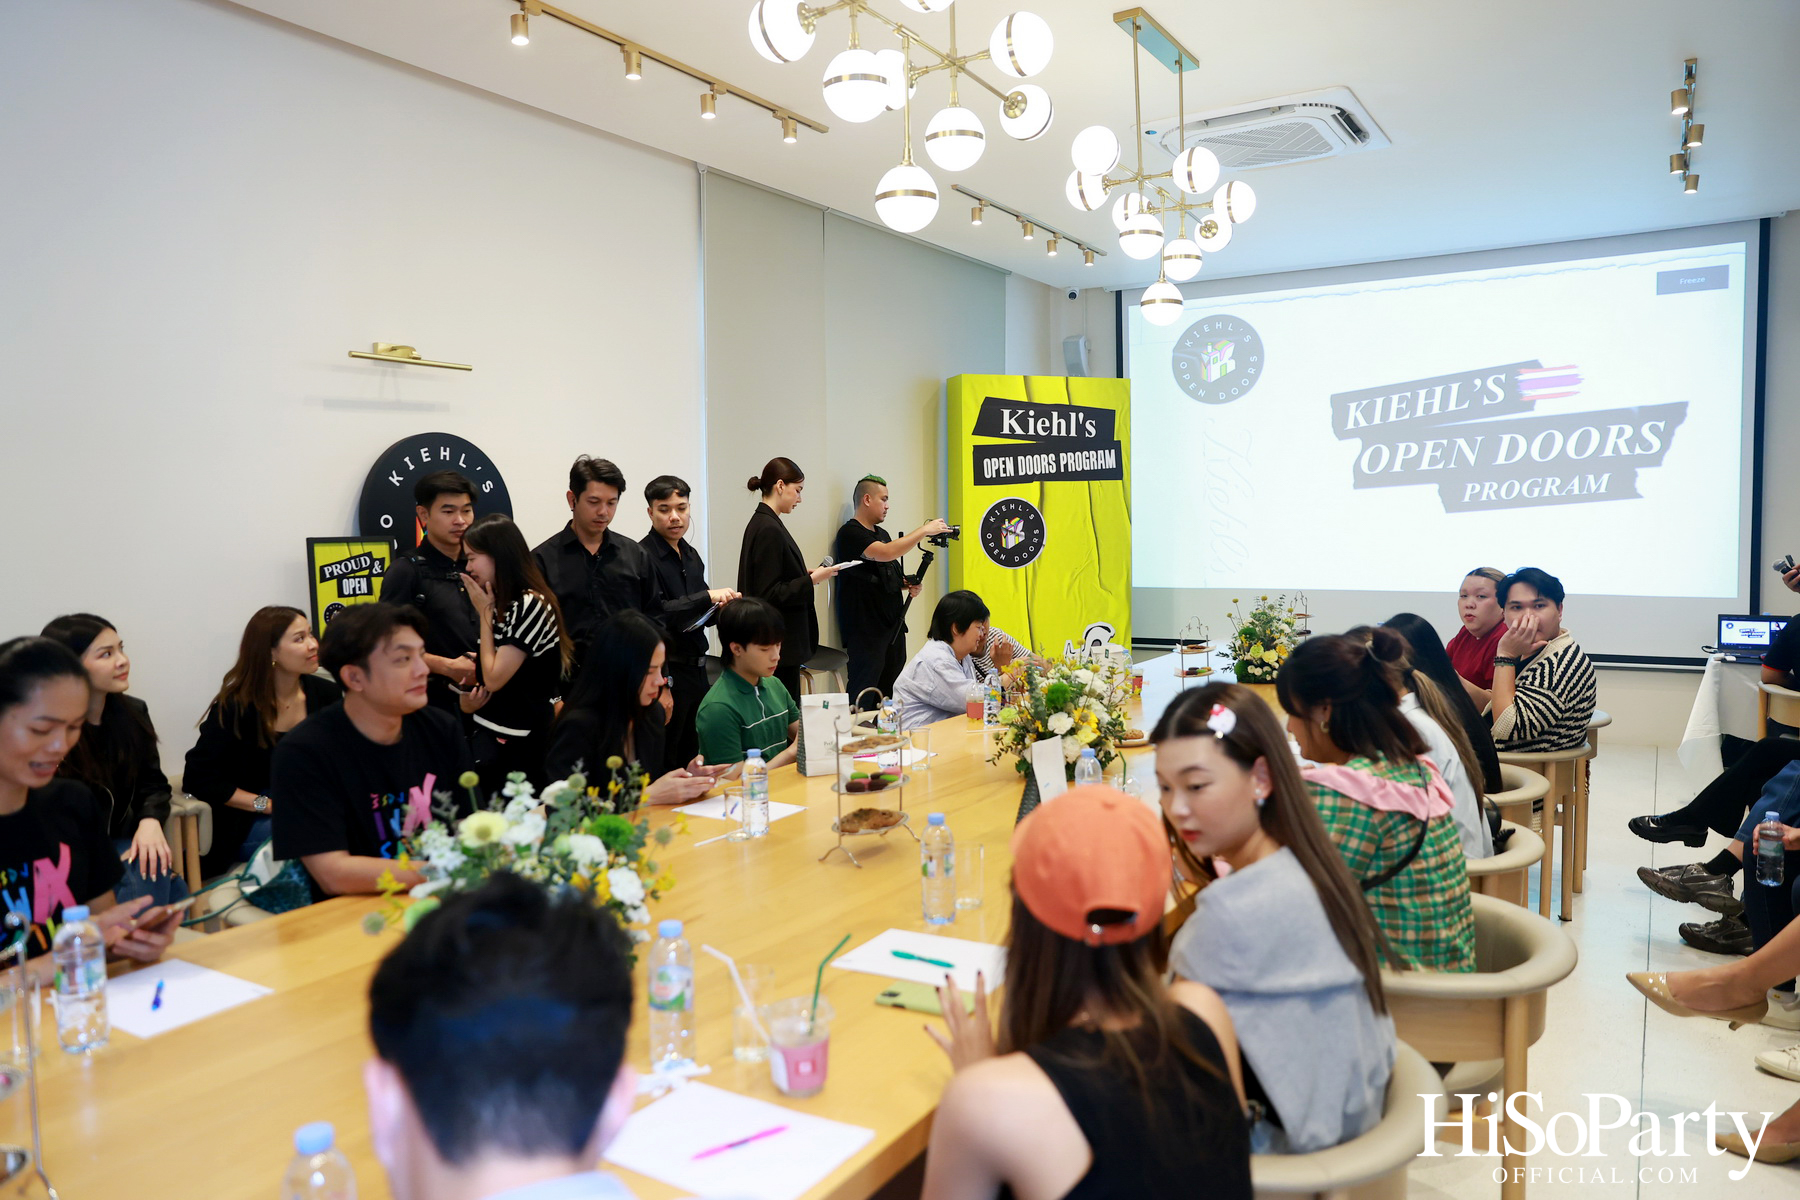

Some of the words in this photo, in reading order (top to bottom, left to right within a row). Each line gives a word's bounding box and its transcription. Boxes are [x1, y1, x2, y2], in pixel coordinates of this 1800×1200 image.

[1679, 277, 1706, 285] Freeze
[1184, 321, 1252, 347] KIEHL'S
[1179, 361, 1206, 397] OPEN
[1219, 355, 1258, 400] DOORS
[1344, 373, 1507, 431] KIEHL'S
[1000, 408, 1097, 438] Kiehl's
[1360, 435, 1485, 475] OPEN
[1492, 420, 1667, 466] DOORS
[388, 446, 494, 493] KIEHL'S
[983, 456, 1015, 479] OPEN
[1017, 453, 1057, 476] DOORS
[1059, 448, 1117, 473] PROGRAM
[1462, 473, 1612, 503] PROGRAM
[989, 503, 1035, 523] KIEHL'S
[986, 532, 1006, 560] OPEN
[1014, 529, 1039, 562] DOORS
[323, 555, 371, 579] PROUD
[372, 560, 383, 575] &
[342, 577, 368, 596] OPEN
